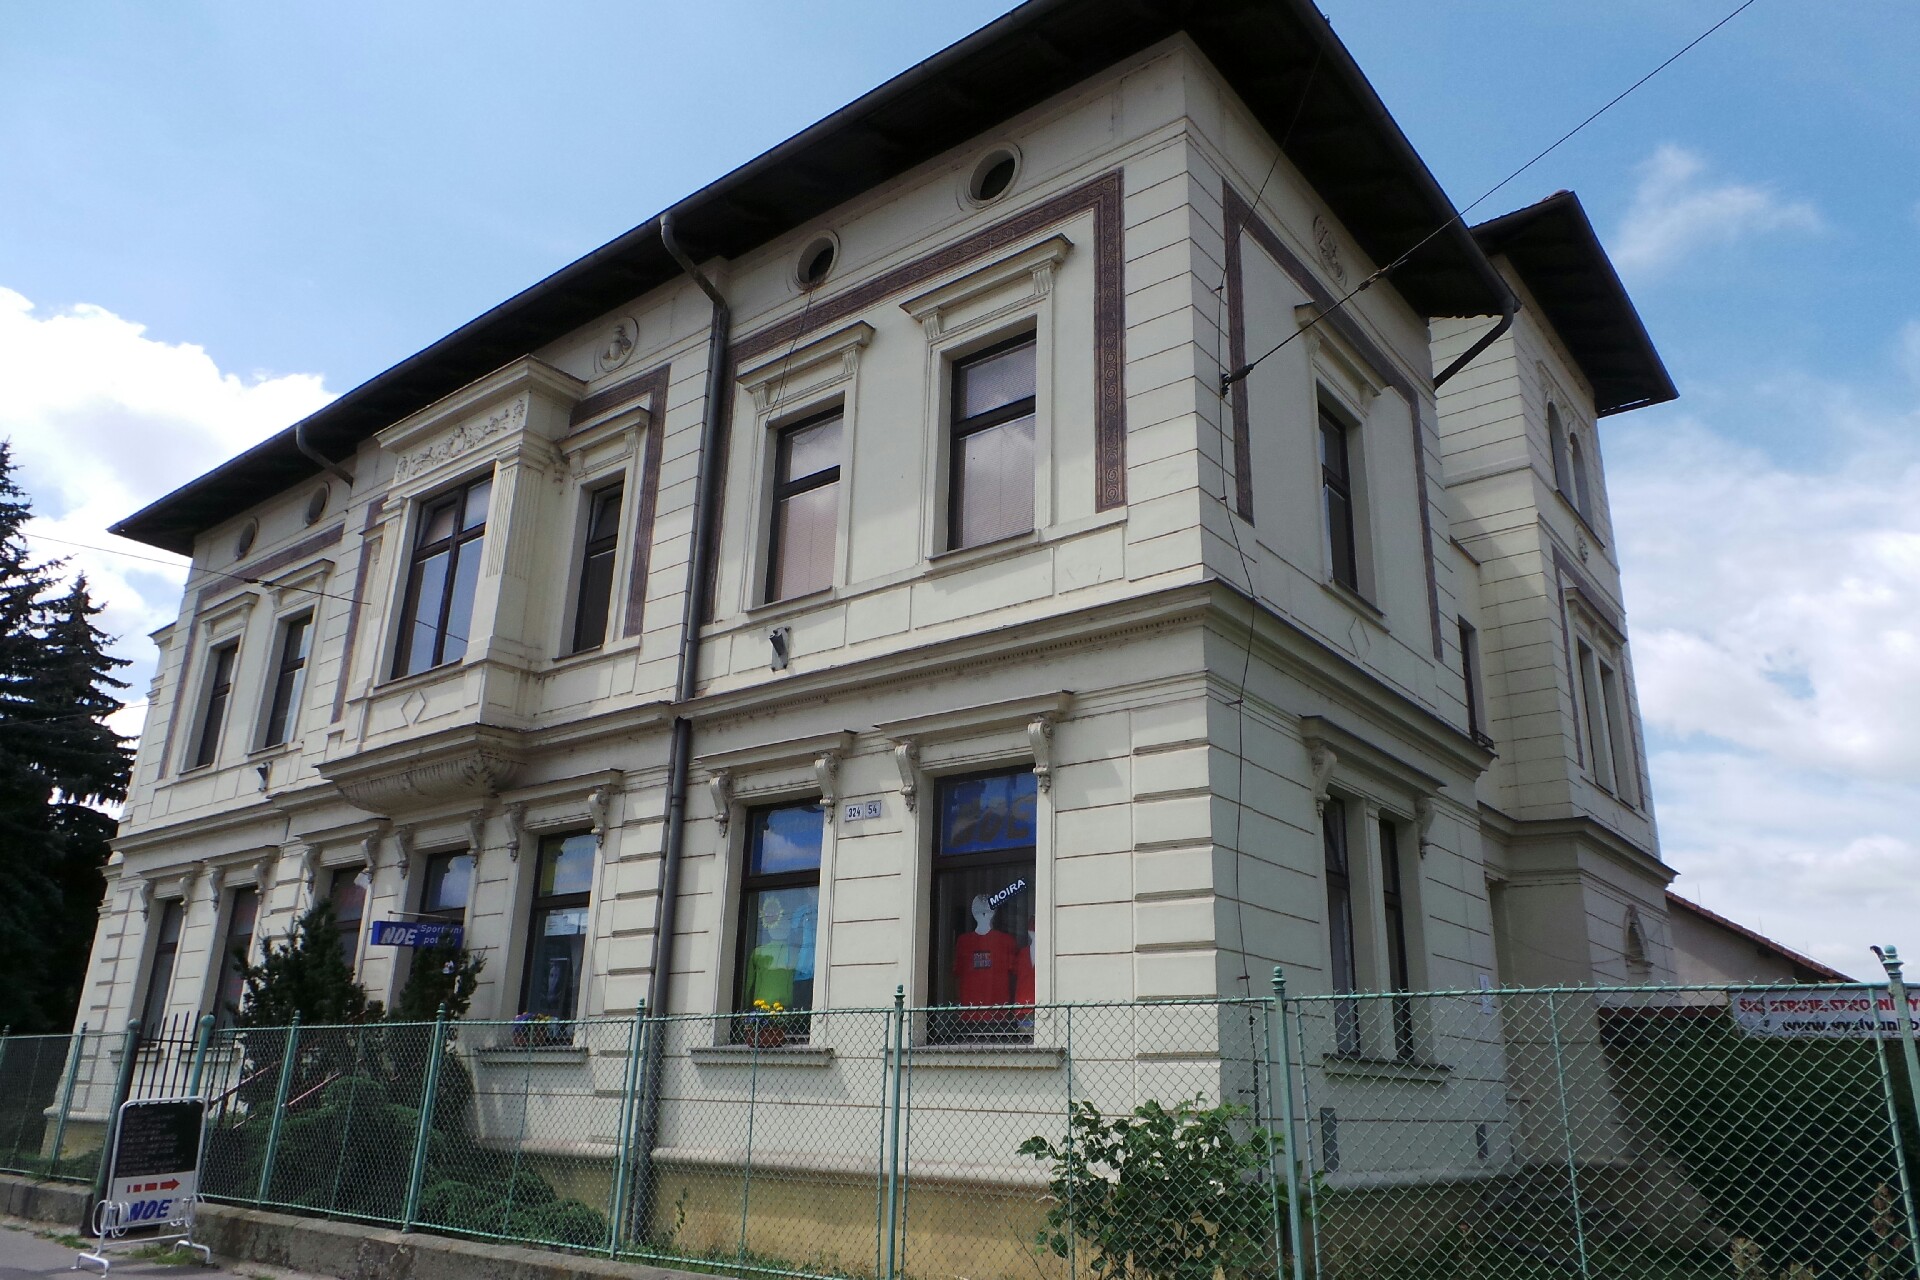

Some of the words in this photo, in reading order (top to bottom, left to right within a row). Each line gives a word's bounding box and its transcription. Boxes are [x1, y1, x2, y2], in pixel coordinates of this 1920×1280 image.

[868, 804, 877, 815] 54
[989, 879, 1026, 906] MOIRA
[420, 924, 462, 934] Sportvní
[1829, 996, 1895, 1012] STRONÍ
